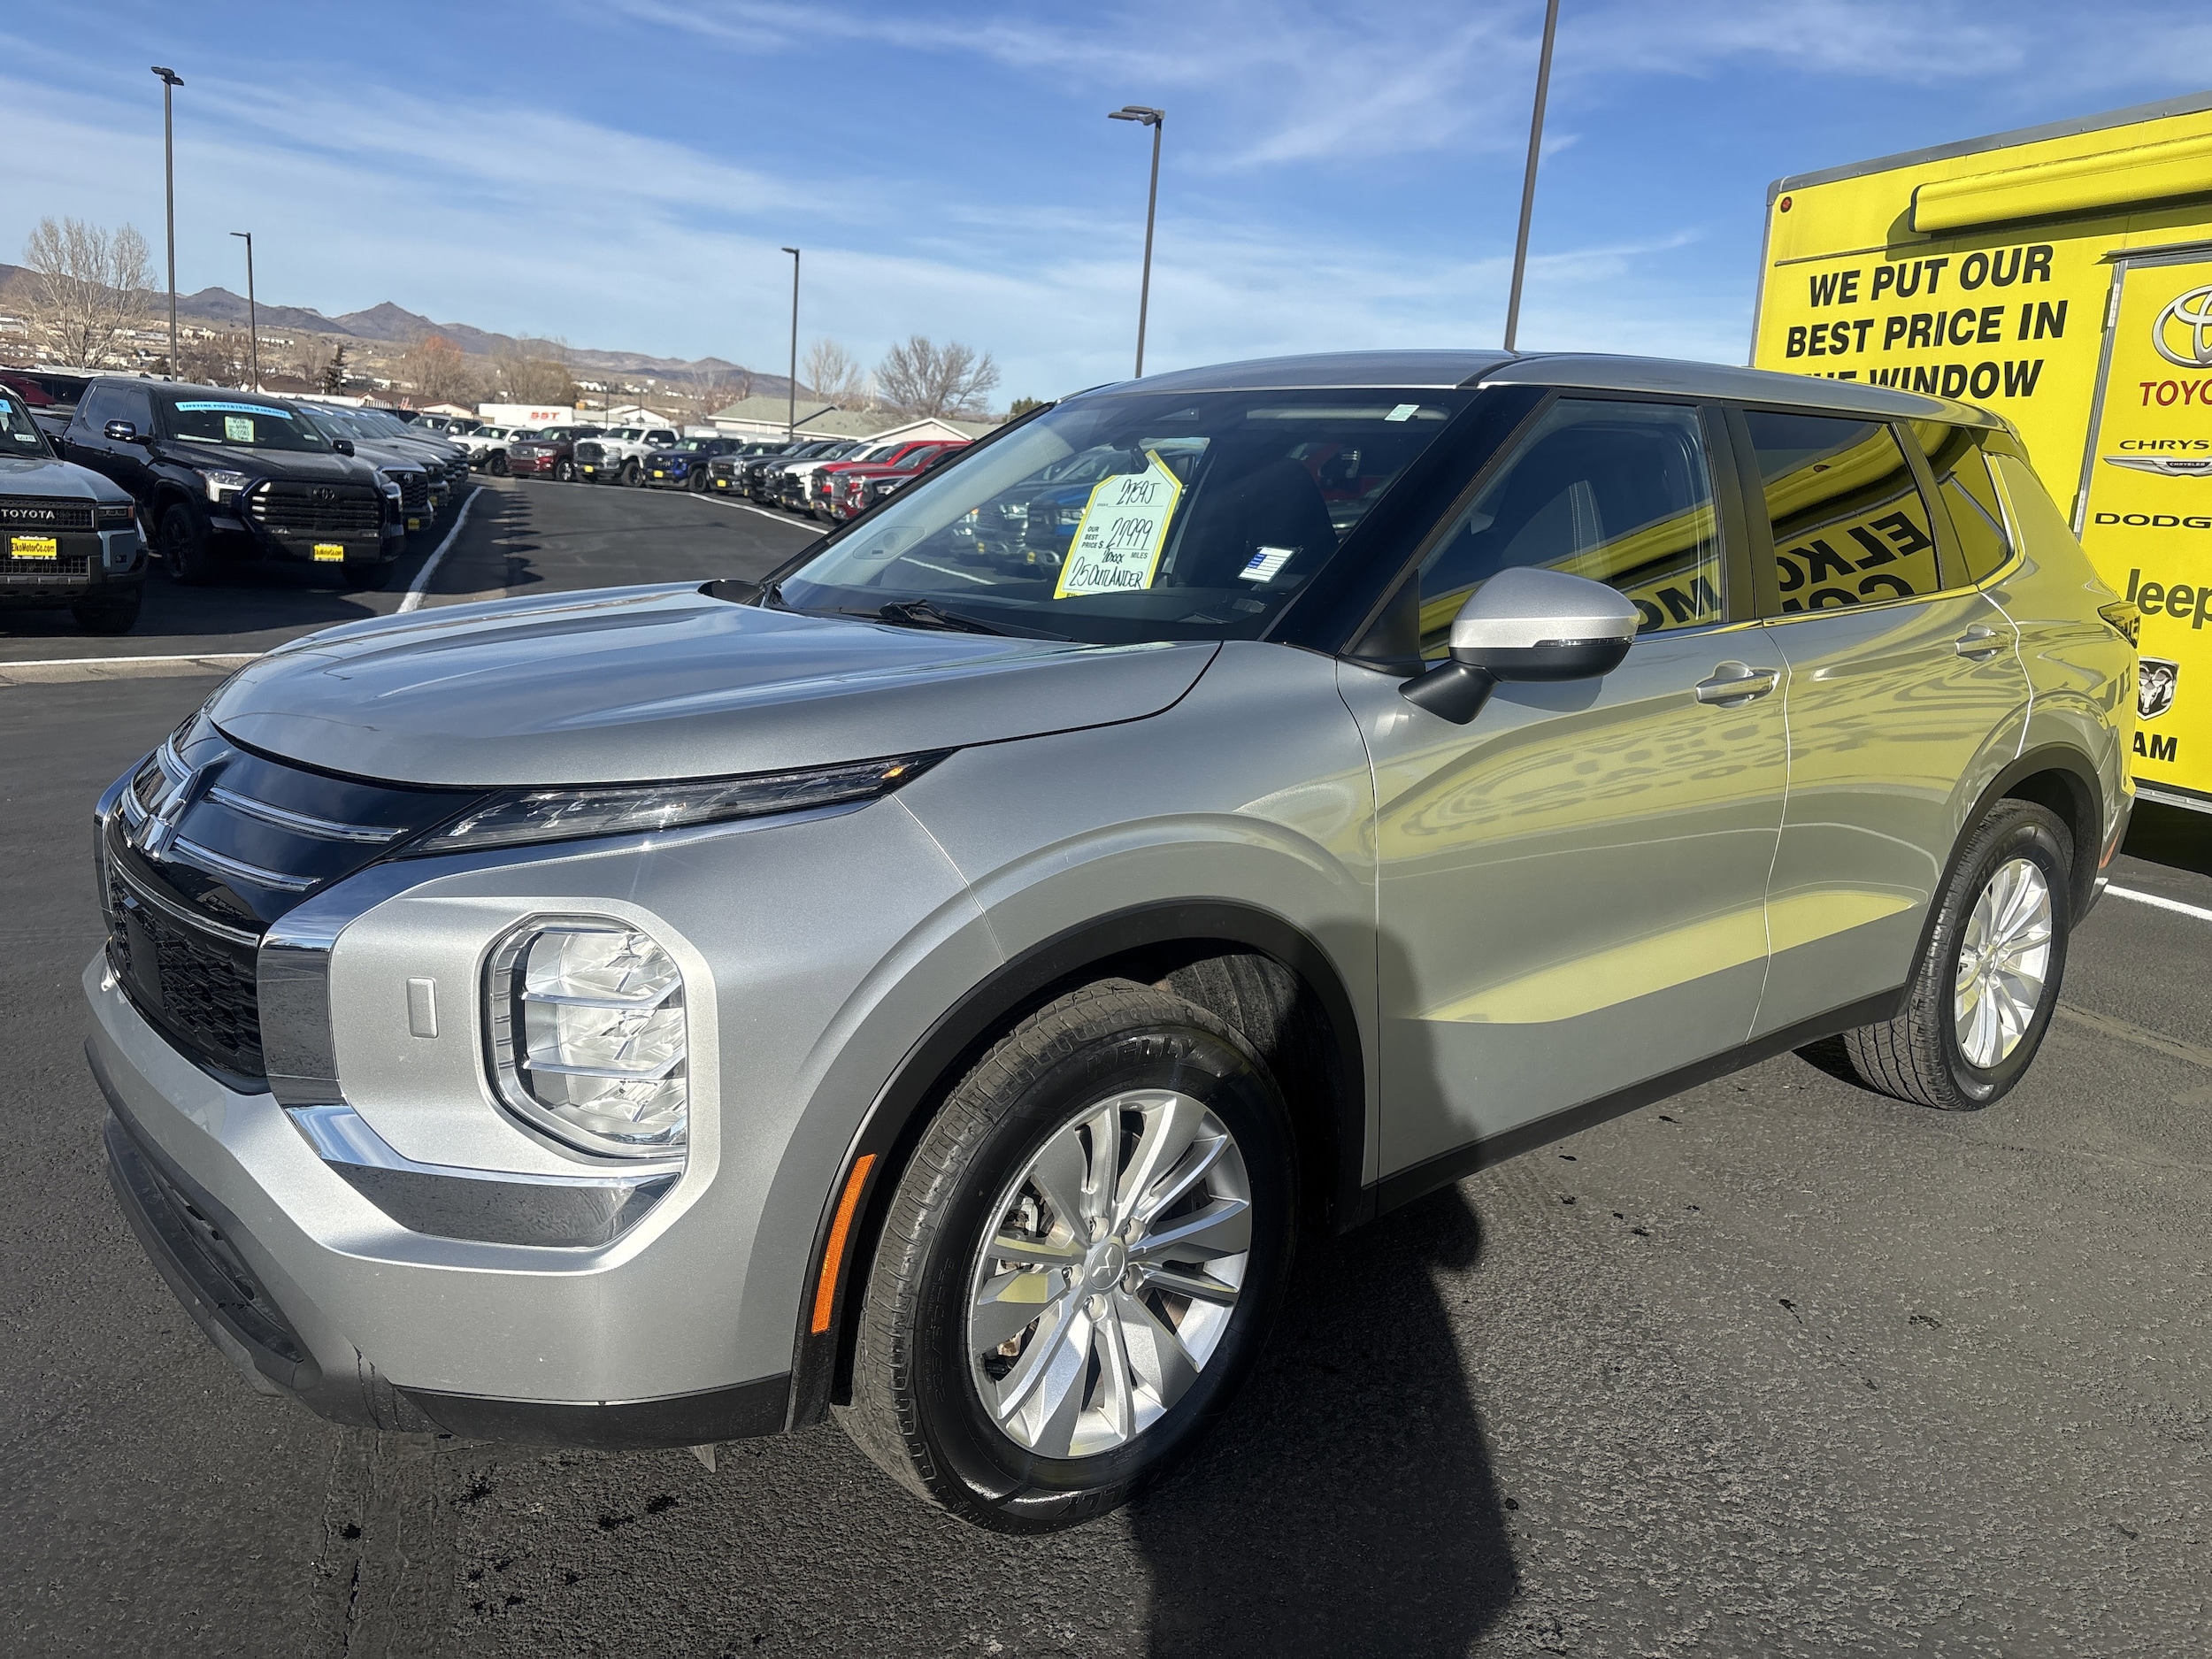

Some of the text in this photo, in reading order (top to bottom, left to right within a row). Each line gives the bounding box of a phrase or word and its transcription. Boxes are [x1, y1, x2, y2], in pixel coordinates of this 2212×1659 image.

[1809, 244, 2054, 307] WE PUT OUR
[1786, 300, 2068, 358] BEST PRICE IN
[2119, 440, 2209, 449] CHRYS
[1, 509, 55, 519] TOYOTA
[2094, 513, 2212, 528] DODG
[1069, 557, 1143, 590] 25 OUTLANDER
[1086, 1036, 1201, 1079] KELLY
